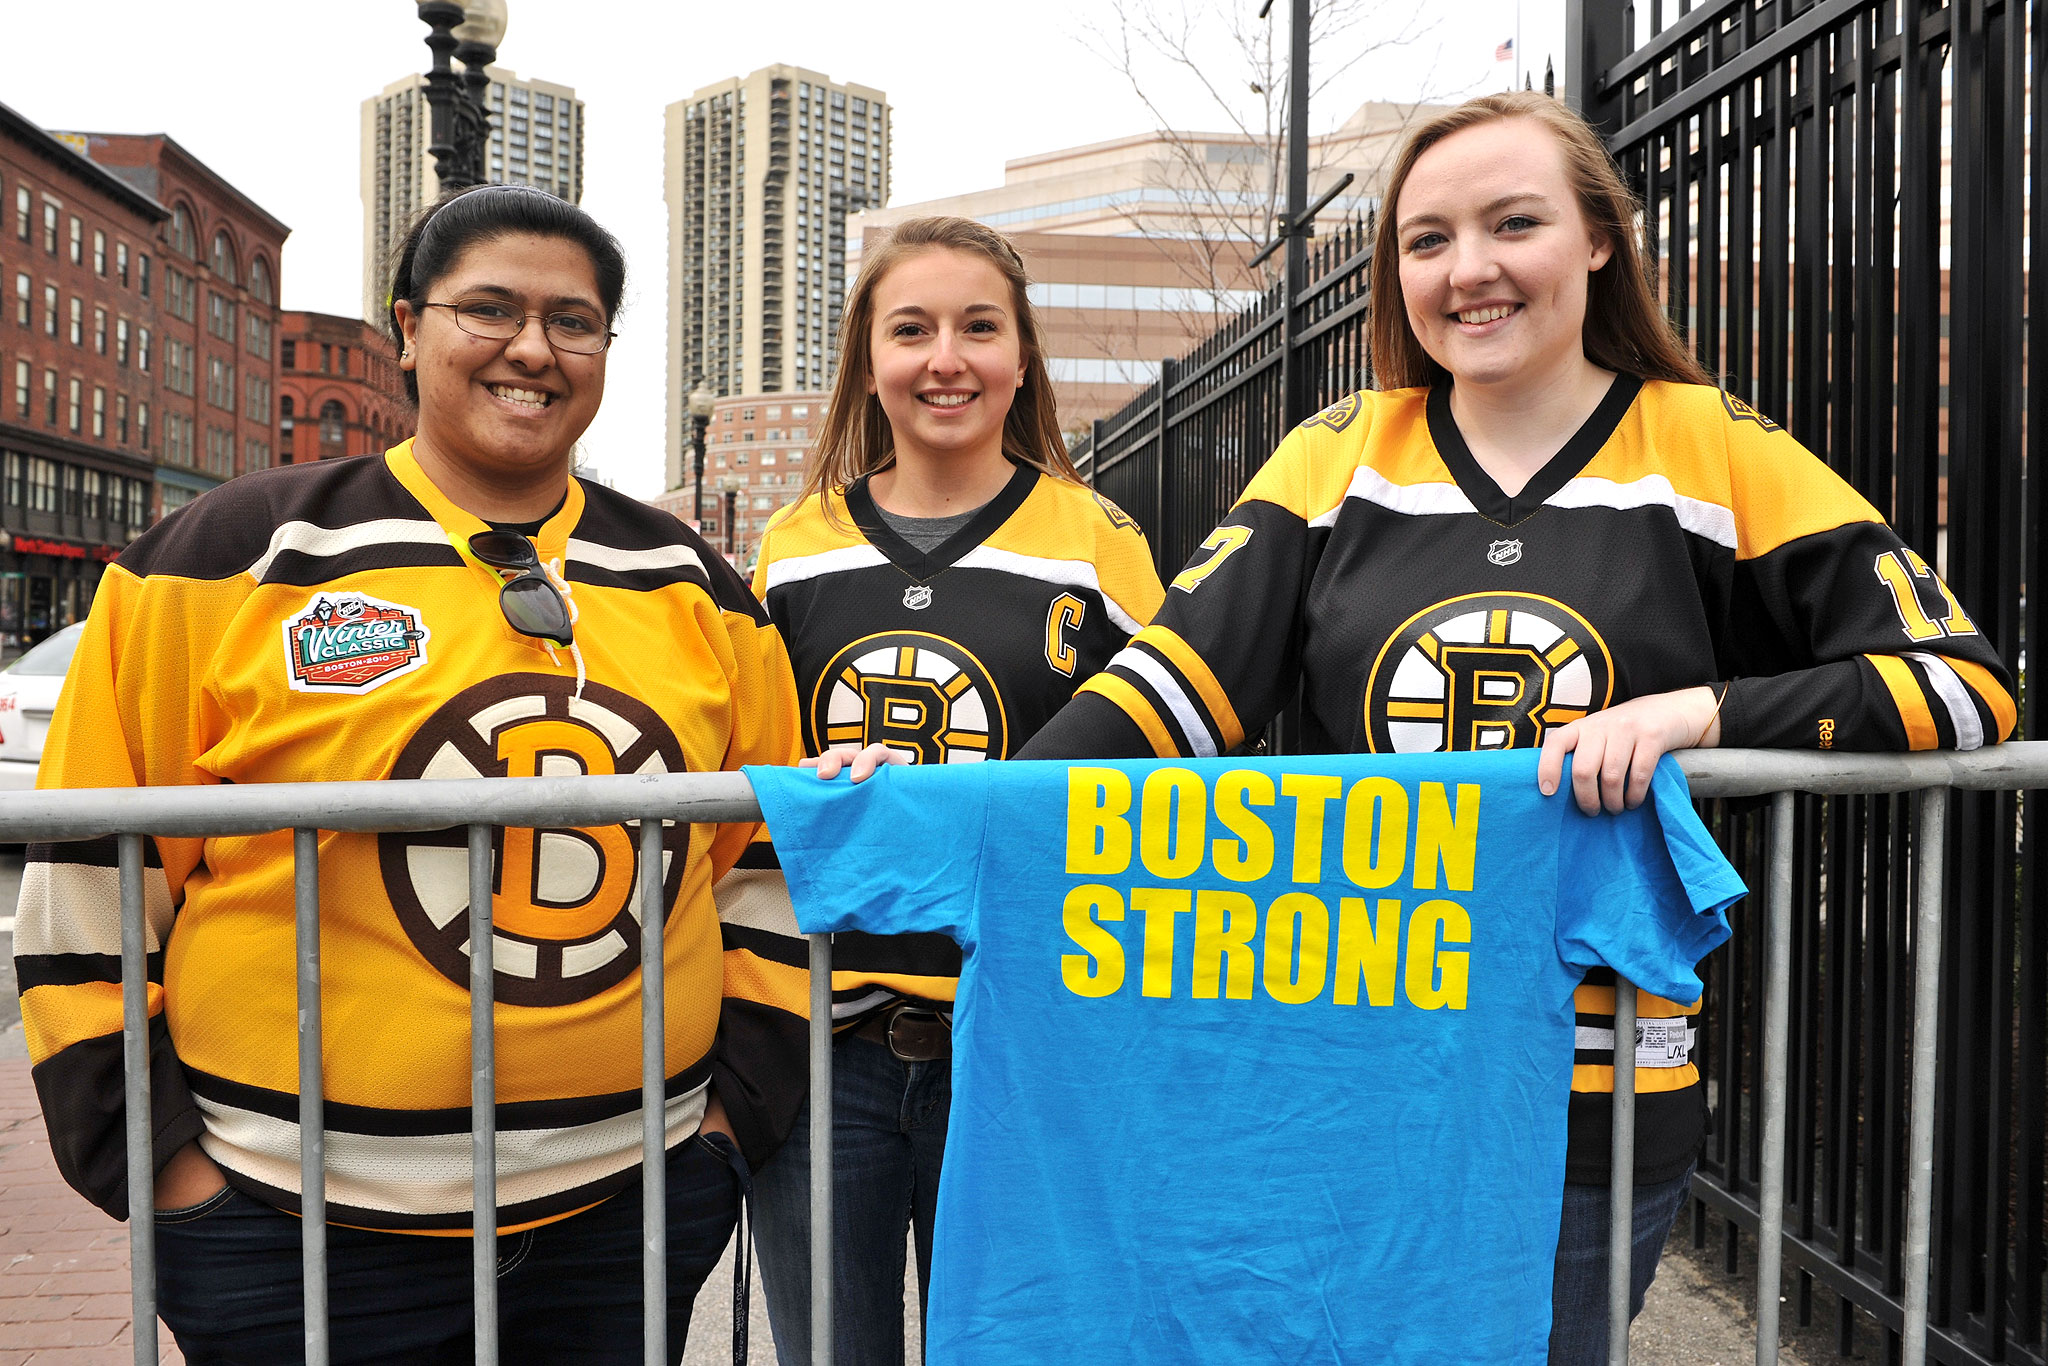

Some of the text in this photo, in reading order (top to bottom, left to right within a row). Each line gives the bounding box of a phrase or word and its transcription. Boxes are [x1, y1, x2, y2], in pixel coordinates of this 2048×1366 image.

[1495, 545, 1518, 561] NHL
[1874, 547, 1979, 643] 17
[297, 618, 406, 663] Winter
[321, 638, 403, 658] CLASSIC
[1045, 591, 1087, 678] C
[492, 720, 635, 941] B
[1065, 766, 1481, 892] BOSTON
[1061, 883, 1472, 1011] STRONG
